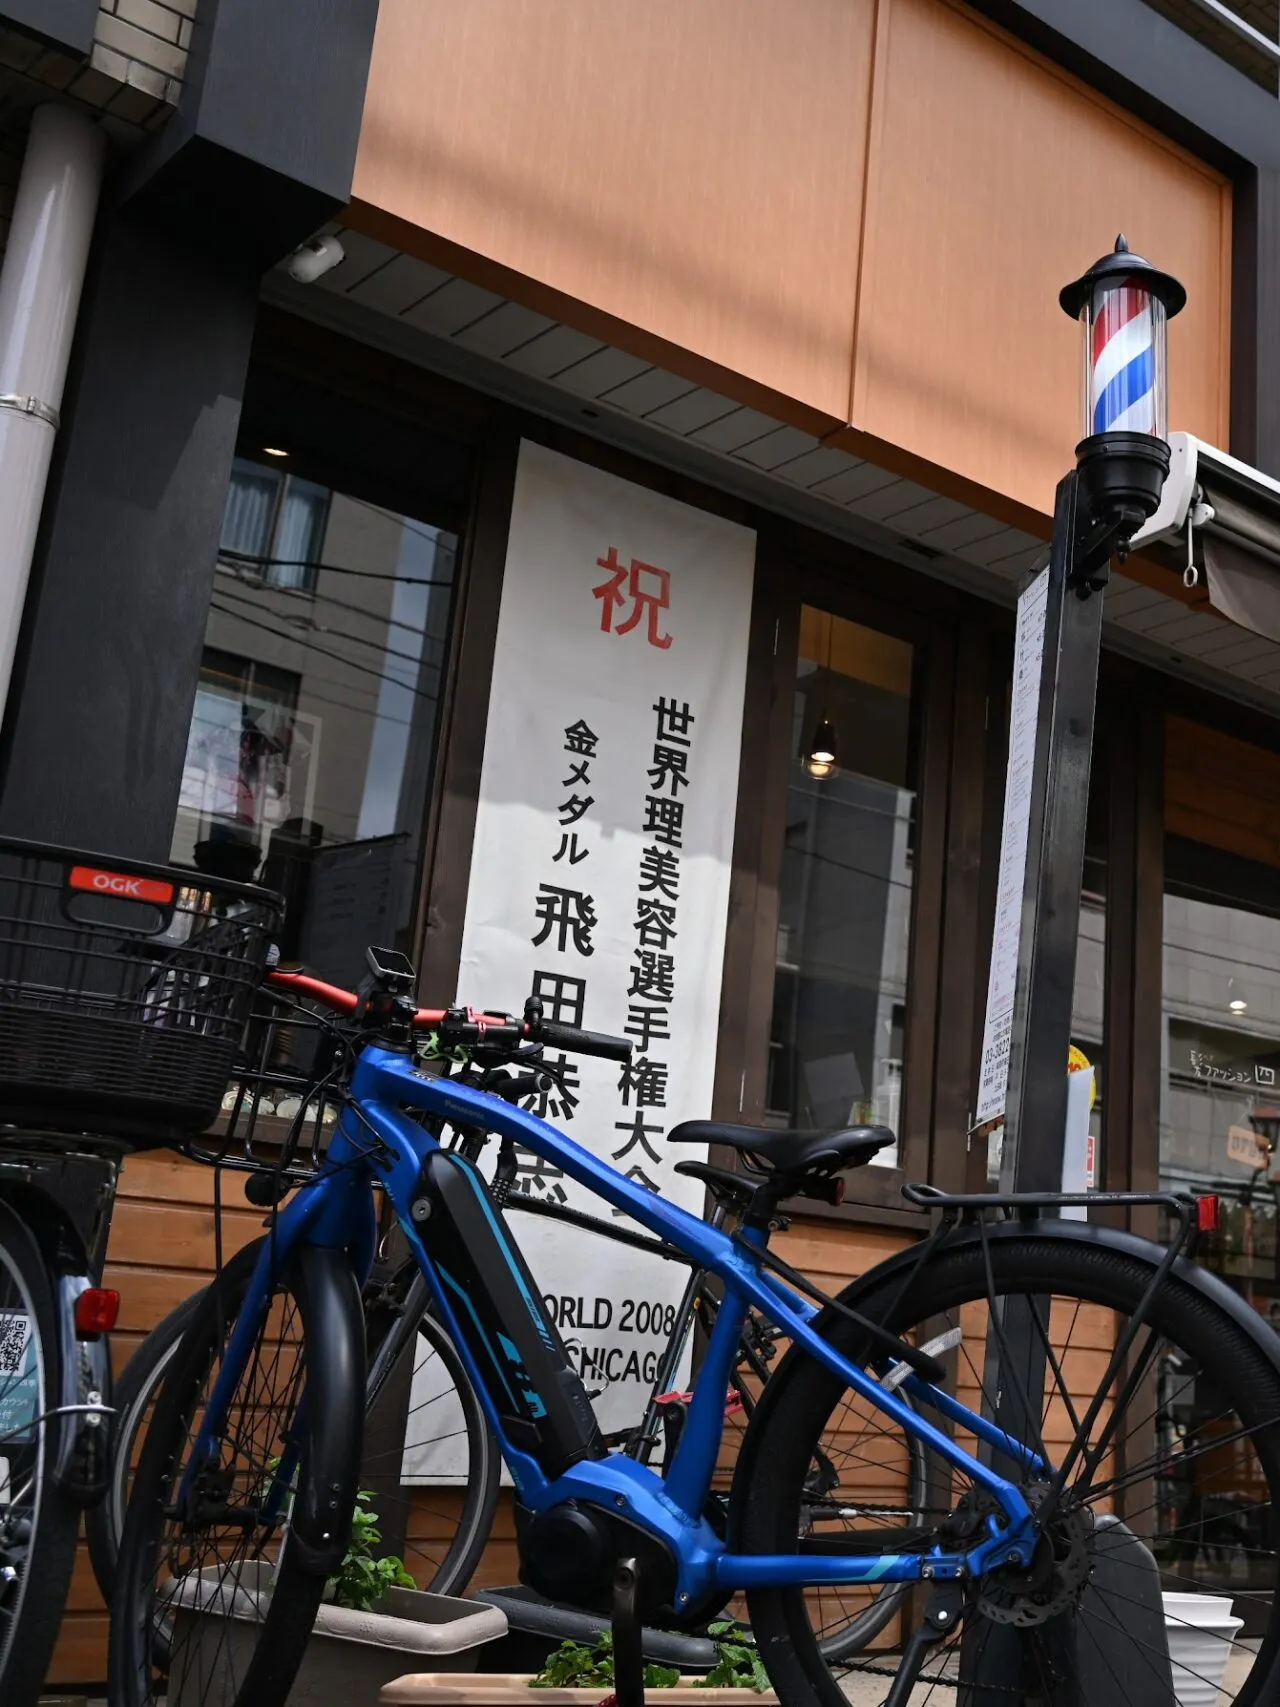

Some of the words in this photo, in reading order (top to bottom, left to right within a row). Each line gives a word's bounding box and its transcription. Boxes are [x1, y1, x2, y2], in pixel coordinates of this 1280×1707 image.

[591, 546, 673, 649] 祝
[552, 718, 600, 866] 金メダル
[92, 873, 142, 896] OGK
[542, 1293, 613, 1330] ORLD
[619, 1299, 676, 1337] 2008
